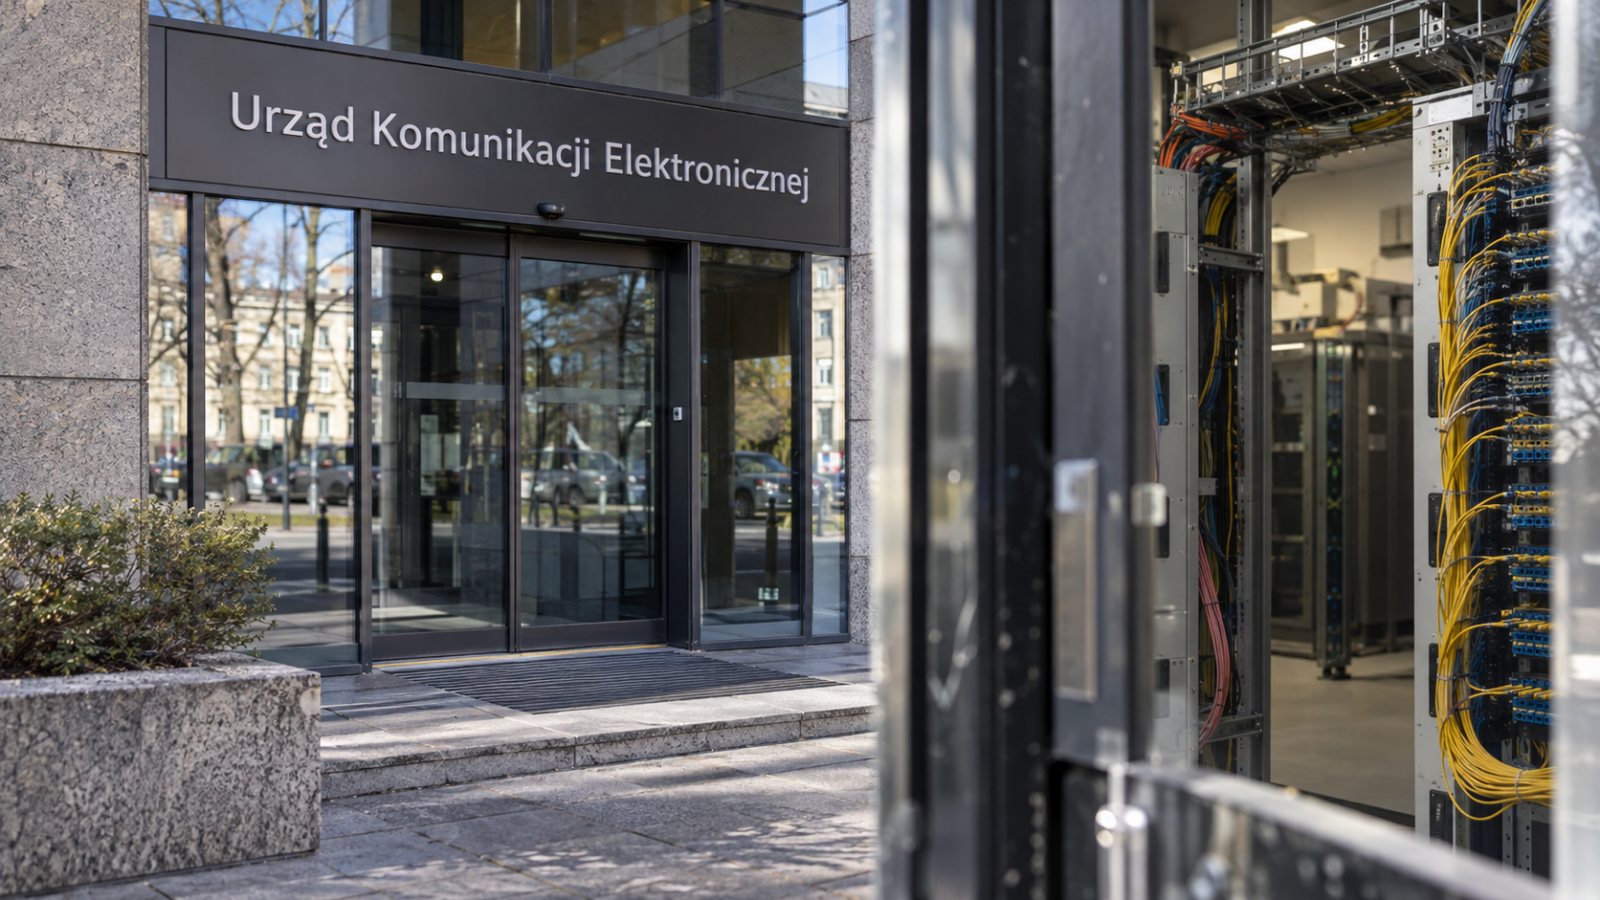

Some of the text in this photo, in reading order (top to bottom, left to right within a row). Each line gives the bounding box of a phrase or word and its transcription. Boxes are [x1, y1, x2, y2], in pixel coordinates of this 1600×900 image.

[231, 91, 810, 204] Urząd Komunikacji Elektronicznej
